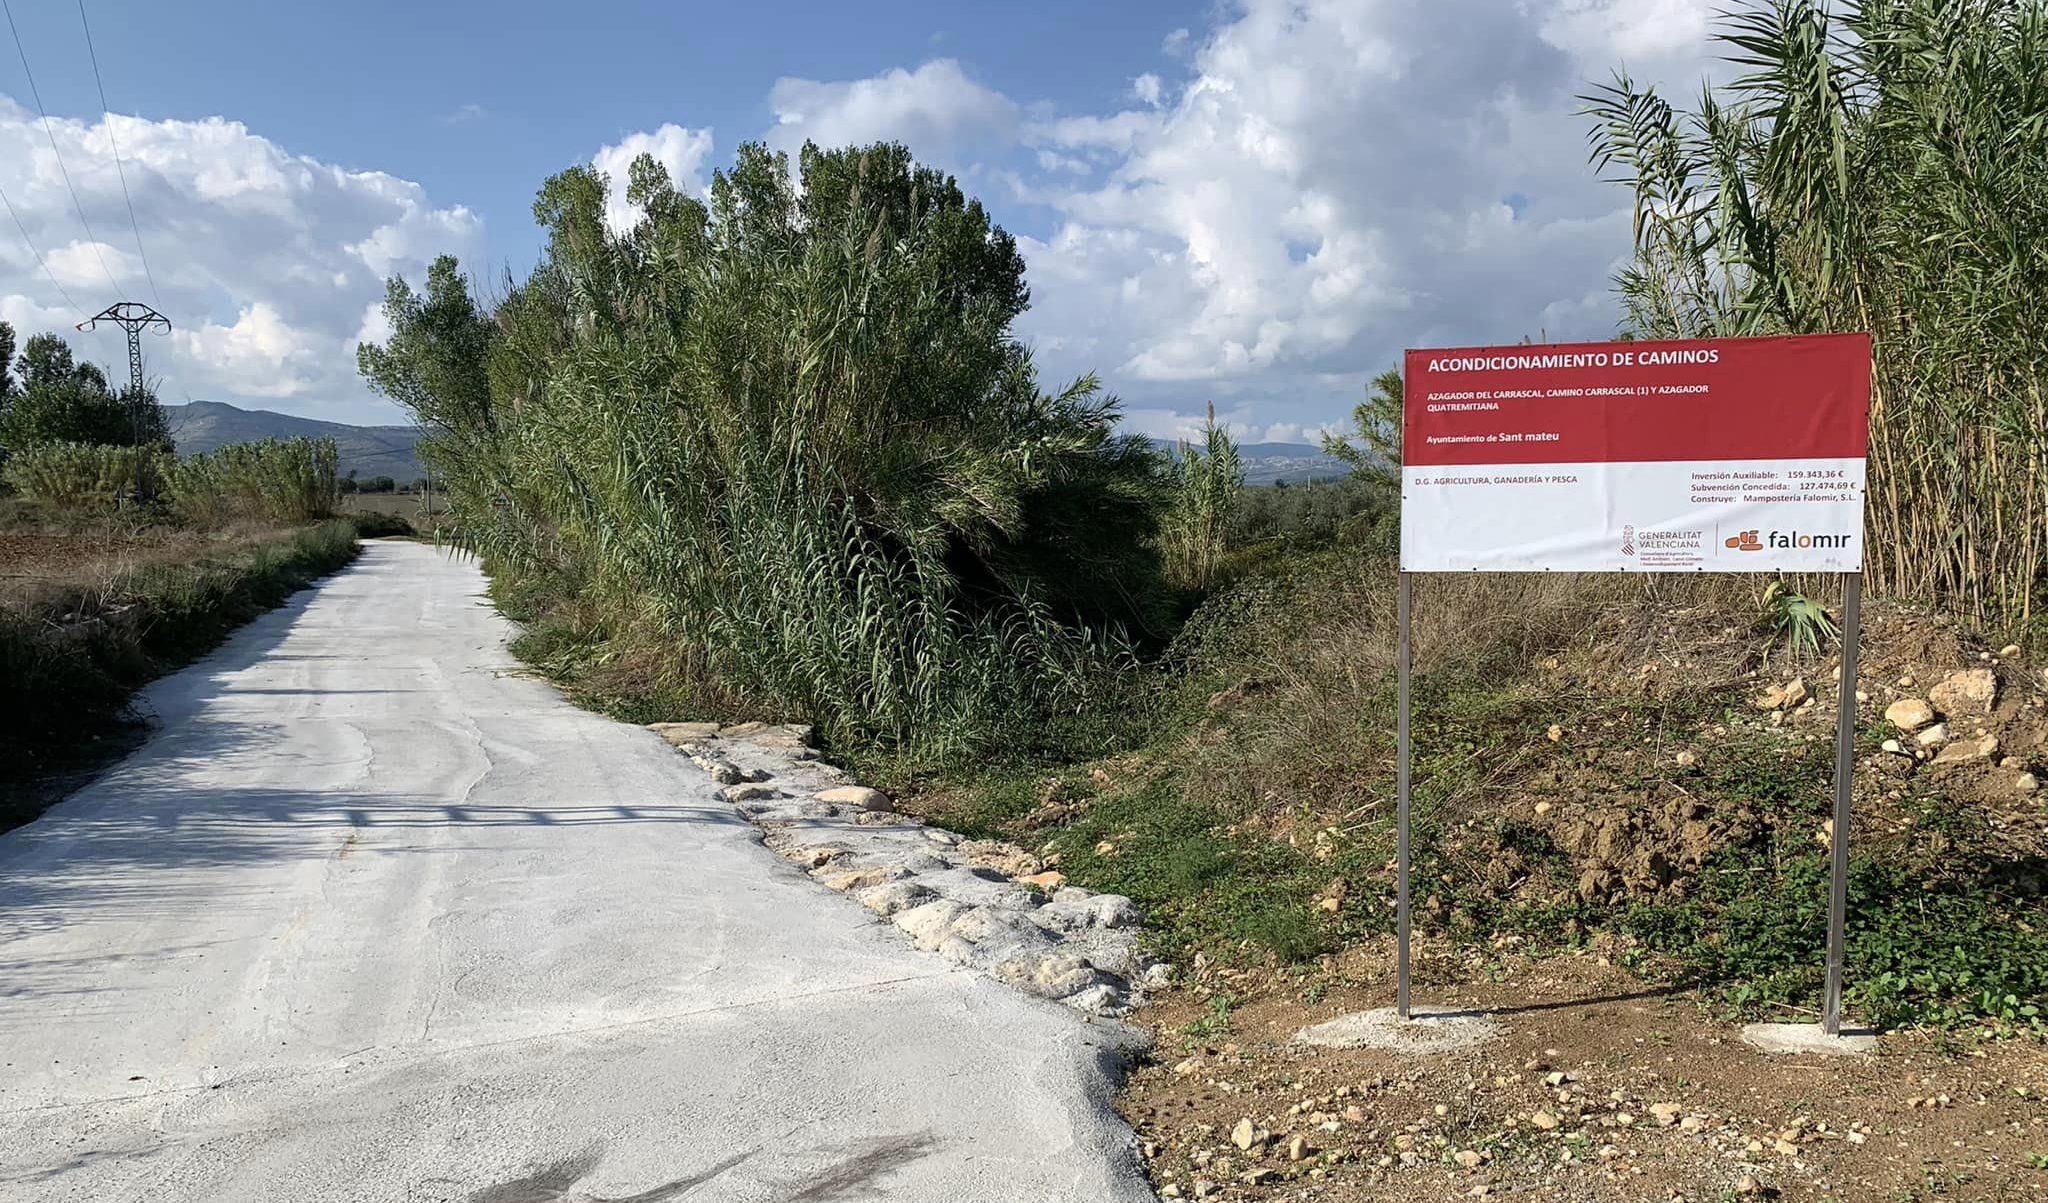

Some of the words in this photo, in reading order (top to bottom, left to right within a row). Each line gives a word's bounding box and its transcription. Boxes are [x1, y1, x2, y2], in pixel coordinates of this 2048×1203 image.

[1428, 353, 1608, 373] ACONDICIONAMIENTO
[1612, 352, 1634, 366] DE
[1638, 349, 1719, 365] CAMINOS
[1427, 392, 1475, 401] AZAGADOR
[1476, 391, 1492, 400] DEL
[1493, 389, 1545, 399] CARRASCAL,
[1546, 388, 1583, 397] CAMINO
[1585, 386, 1635, 396] CARRASCAL
[1636, 386, 1649, 396] (1)
[1650, 386, 1657, 395] Y
[1658, 384, 1709, 394] AZAGADOR
[1426, 435, 1485, 445] Ayuntamiento
[1486, 433, 1498, 443] de
[1499, 432, 1523, 443] Sant
[1525, 432, 1560, 442] mateu
[1415, 478, 1432, 486] D.G.
[1434, 476, 1492, 486] AGRICULTURA,
[1493, 474, 1543, 485] GANADERÍA
[1545, 476, 1550, 484] Y
[1552, 475, 1578, 484] PESCA
[1691, 471, 1730, 481] Inversión
[1732, 471, 1779, 480] Auxiliable:
[1787, 470, 1836, 480] 159.343,36
[1837, 470, 1845, 479] €
[1691, 483, 1741, 492] Subvención
[1742, 483, 1791, 491] Concedida:
[1799, 482, 1848, 491] 127.474,69
[1849, 482, 1857, 490] €
[1690, 494, 1737, 503] Construye:
[1803, 493, 1839, 502] Falomir,
[1840, 493, 1857, 502] S.L.
[1638, 530, 1703, 541] GENERALITAT
[1768, 530, 1852, 550] falomir
[1639, 540, 1701, 549] VALENCIANA
